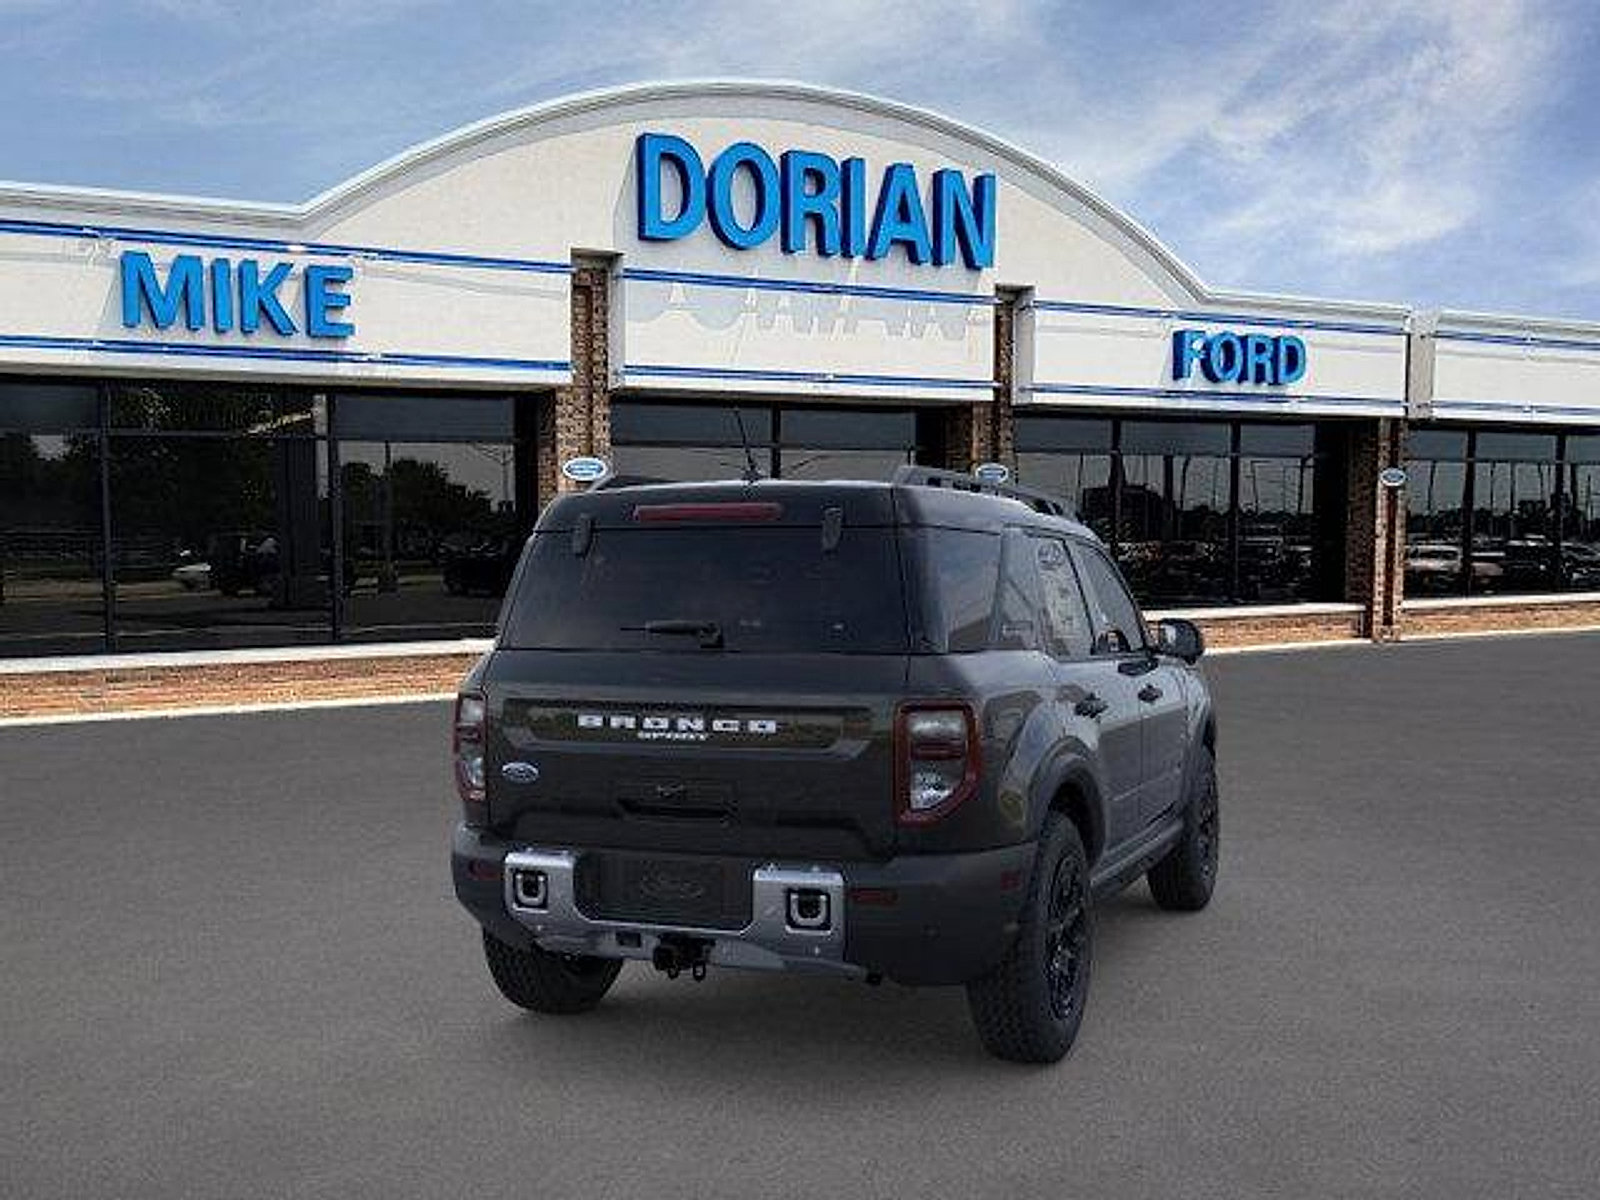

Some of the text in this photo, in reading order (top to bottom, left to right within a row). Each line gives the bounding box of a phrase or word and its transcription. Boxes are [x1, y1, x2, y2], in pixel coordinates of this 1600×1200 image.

[636, 132, 996, 271] DORIAN
[120, 250, 355, 338] MIKE
[1172, 330, 1307, 386] FORD
[577, 714, 777, 735] BRONCO
